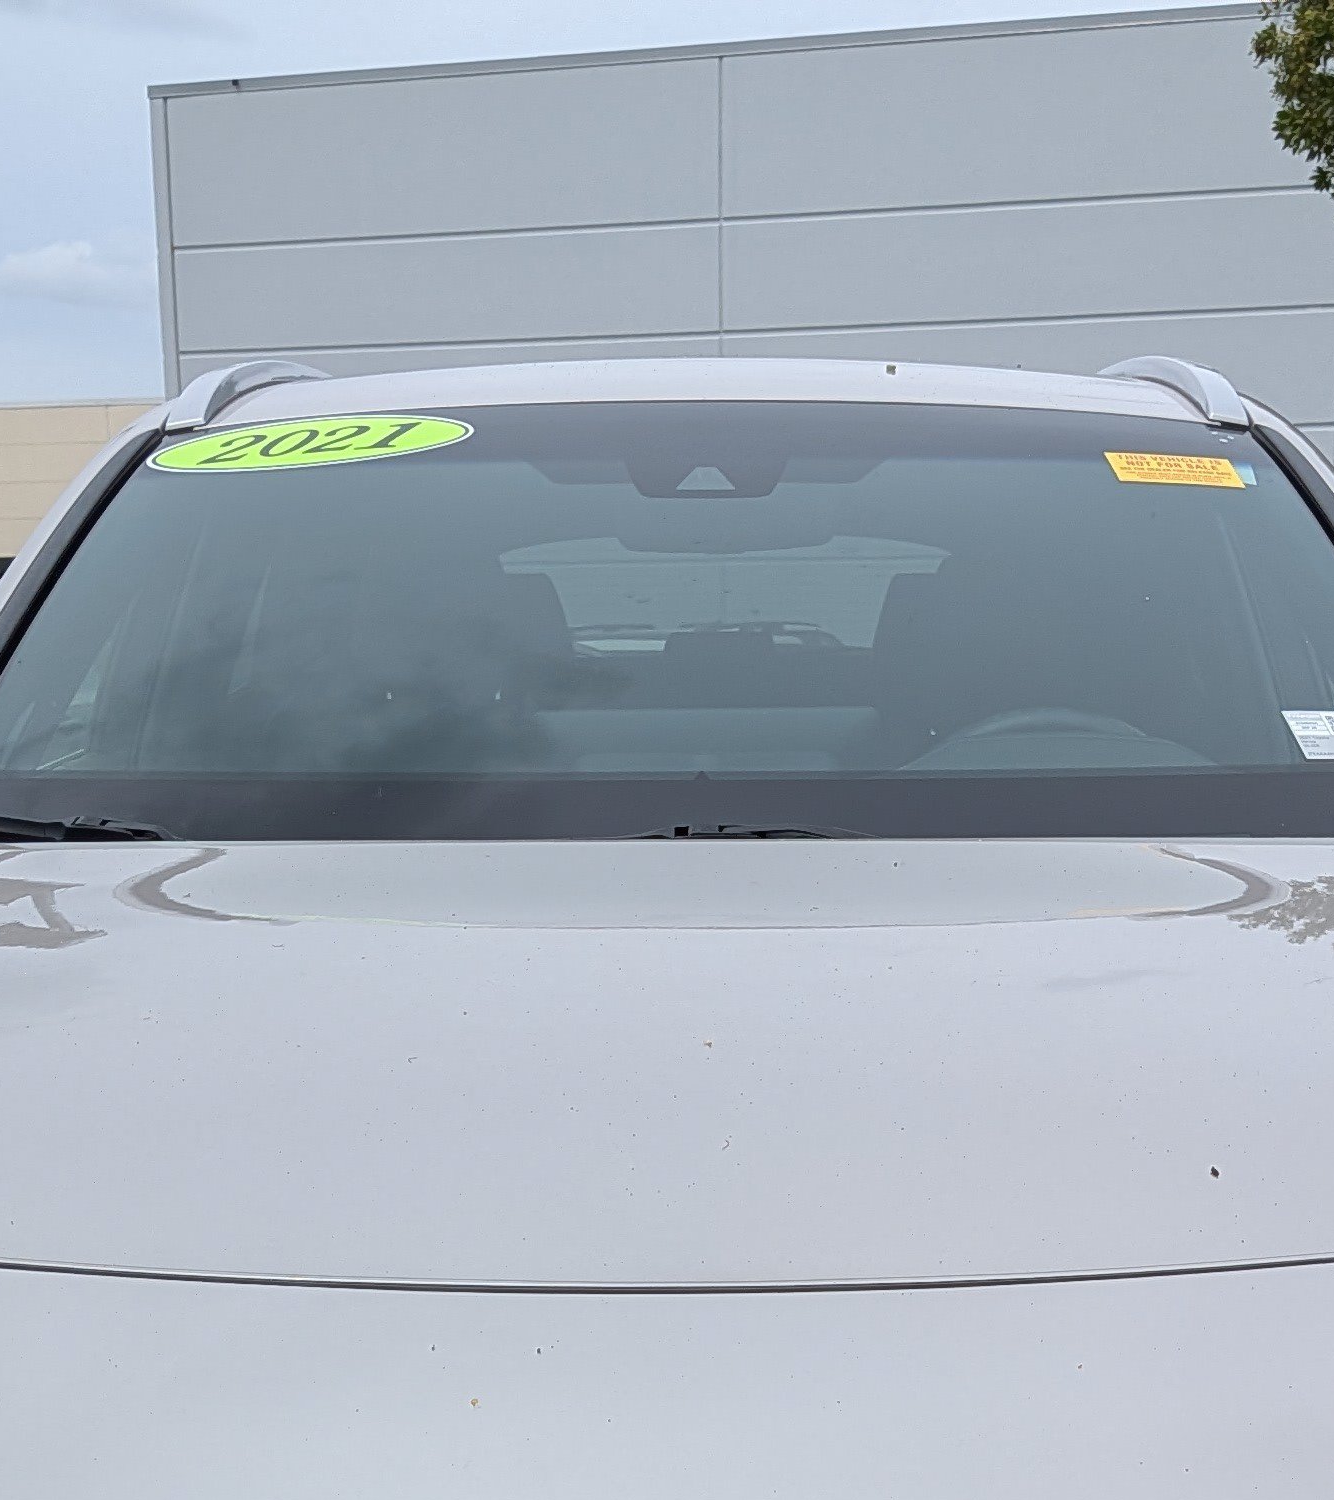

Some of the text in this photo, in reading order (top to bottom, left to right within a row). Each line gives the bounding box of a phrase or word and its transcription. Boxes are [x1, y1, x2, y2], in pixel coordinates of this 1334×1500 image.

[195, 421, 422, 466] 2021
[1150, 455, 1204, 464] VEHICLE
[1157, 461, 1182, 469] FOR
[1186, 463, 1219, 471] SALE
